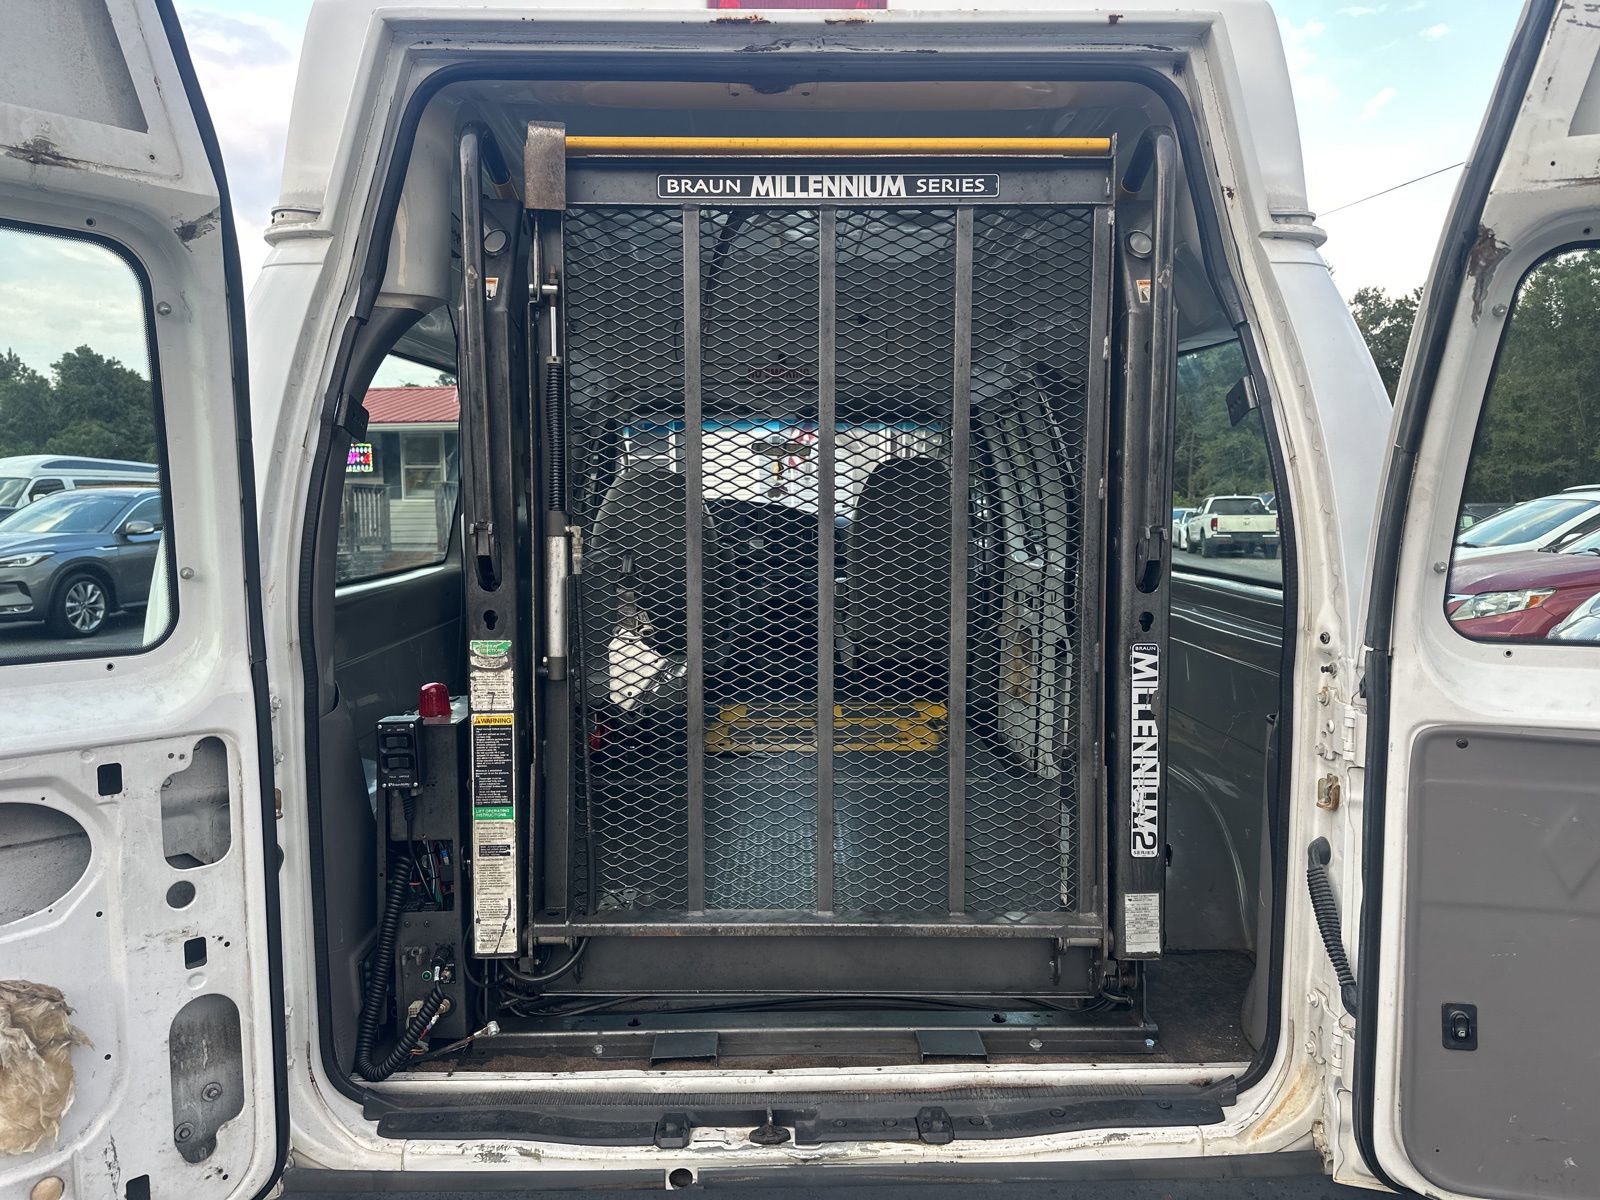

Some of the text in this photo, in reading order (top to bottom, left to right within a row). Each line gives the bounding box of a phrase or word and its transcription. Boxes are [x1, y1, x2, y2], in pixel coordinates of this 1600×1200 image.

[667, 175, 985, 198] BRAUN MILLENNIUM SERIES
[1132, 651, 1158, 831] MILLENNIUM
